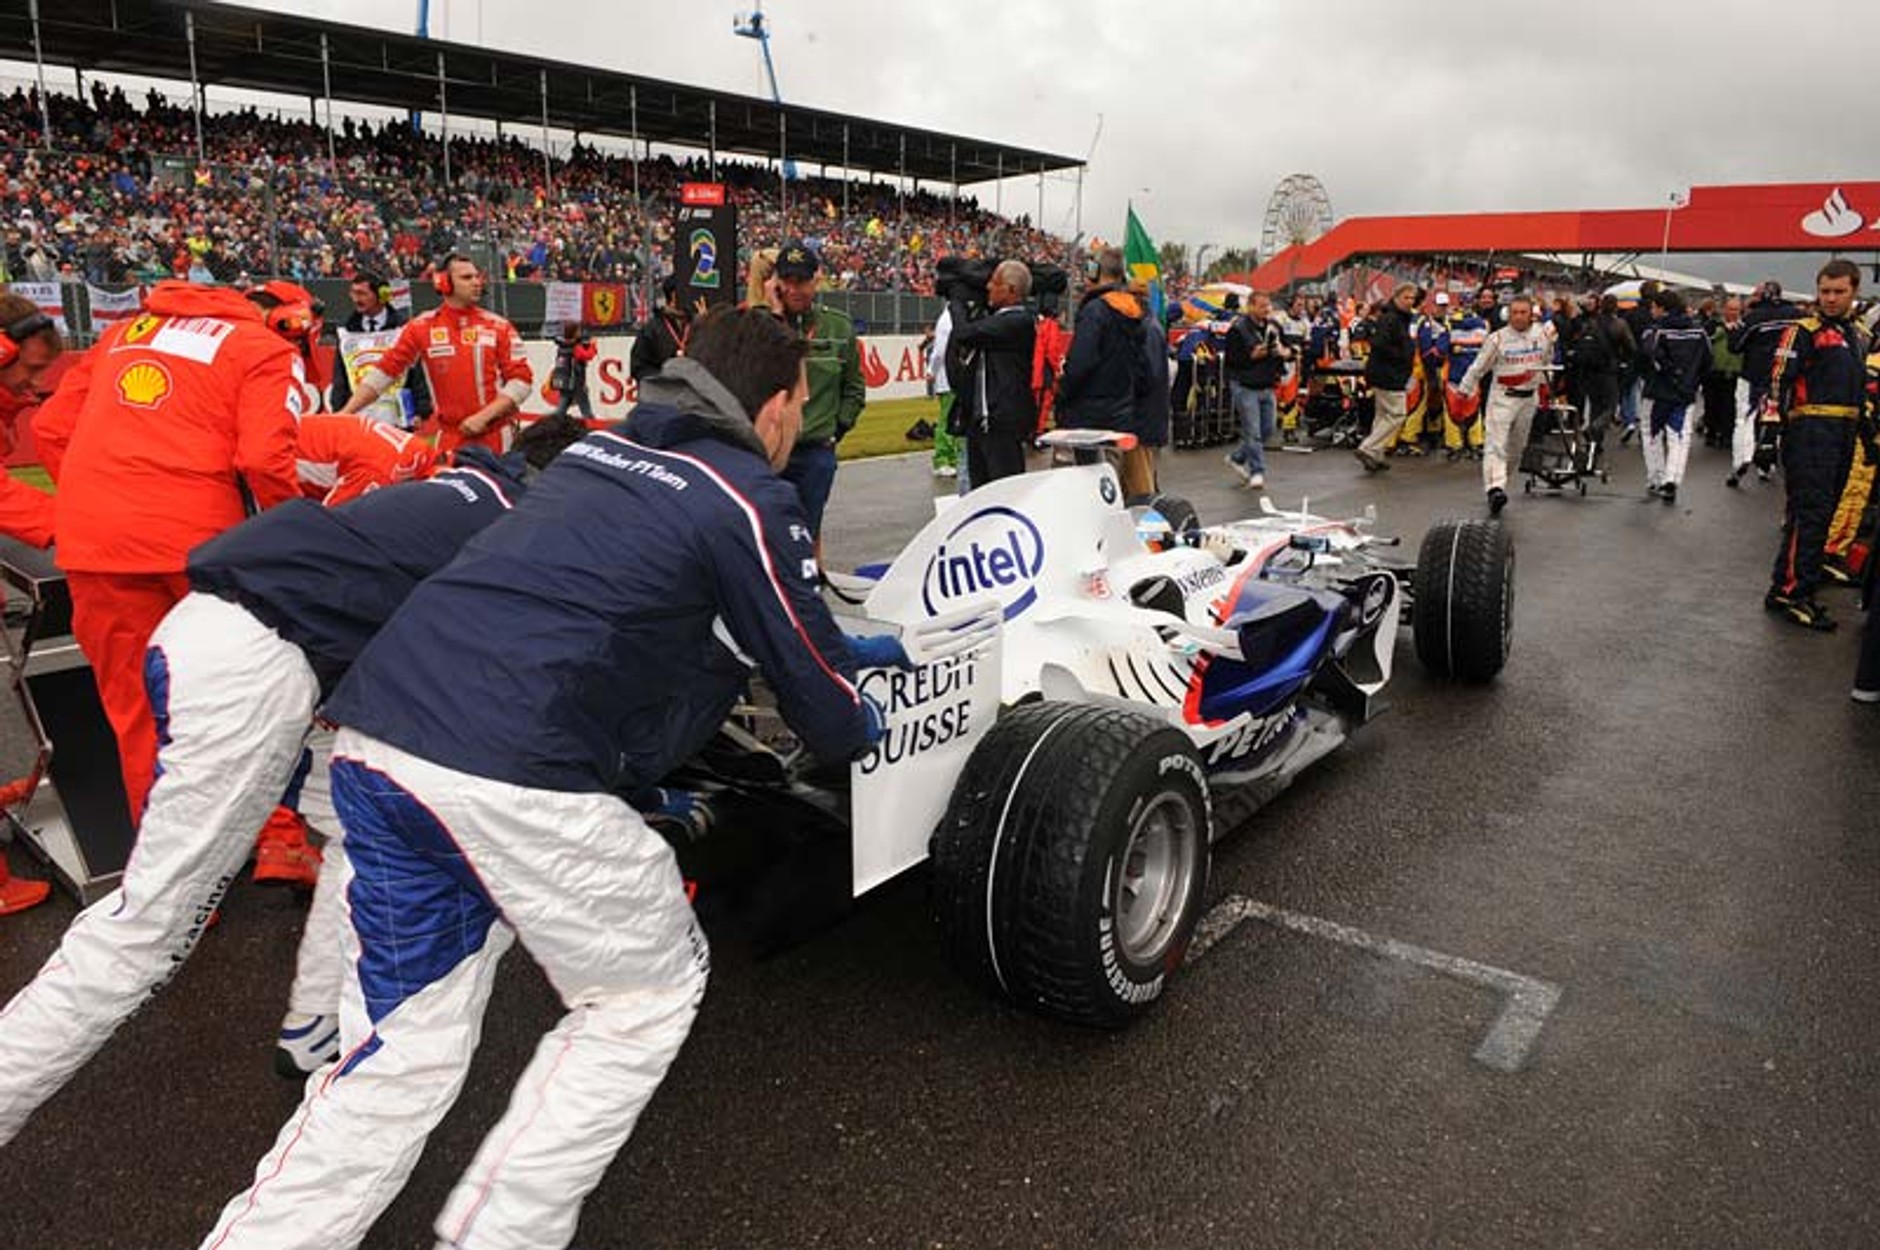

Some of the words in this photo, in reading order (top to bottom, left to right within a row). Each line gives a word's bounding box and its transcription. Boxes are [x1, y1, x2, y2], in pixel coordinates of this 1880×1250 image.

[689, 227, 720, 289] 2
[938, 531, 1029, 598] intel
[857, 649, 977, 714] CREDIT
